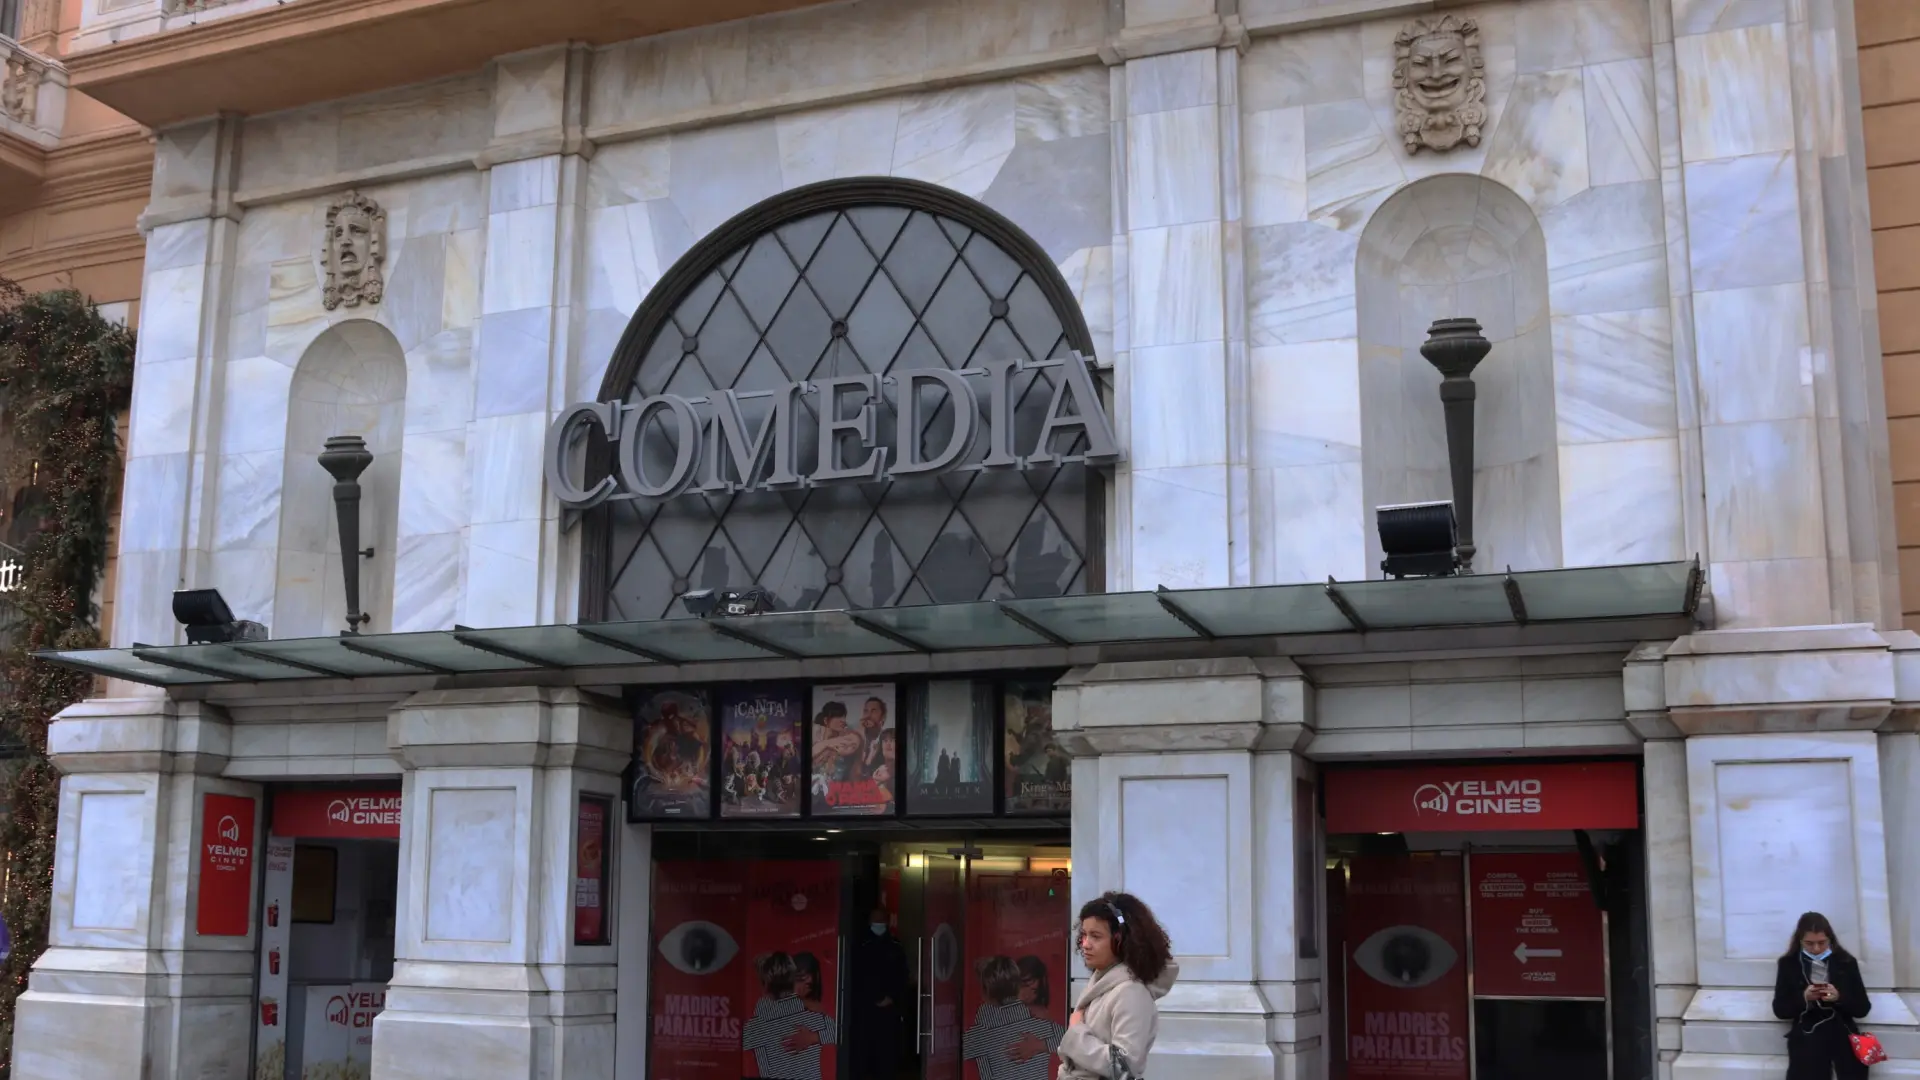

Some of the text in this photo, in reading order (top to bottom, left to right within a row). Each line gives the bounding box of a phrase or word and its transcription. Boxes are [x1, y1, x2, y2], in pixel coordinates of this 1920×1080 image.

[543, 350, 1126, 506] COMEDIA
[1442, 779, 1542, 796] YELMO
[1455, 798, 1542, 815] CINES
[206, 844, 248, 857] YELMO
[664, 994, 731, 1017] MADRES
[654, 1015, 741, 1040] PARALELAS
[1364, 1010, 1450, 1036] MADRES
[1351, 1035, 1465, 1061] PARALELAS
